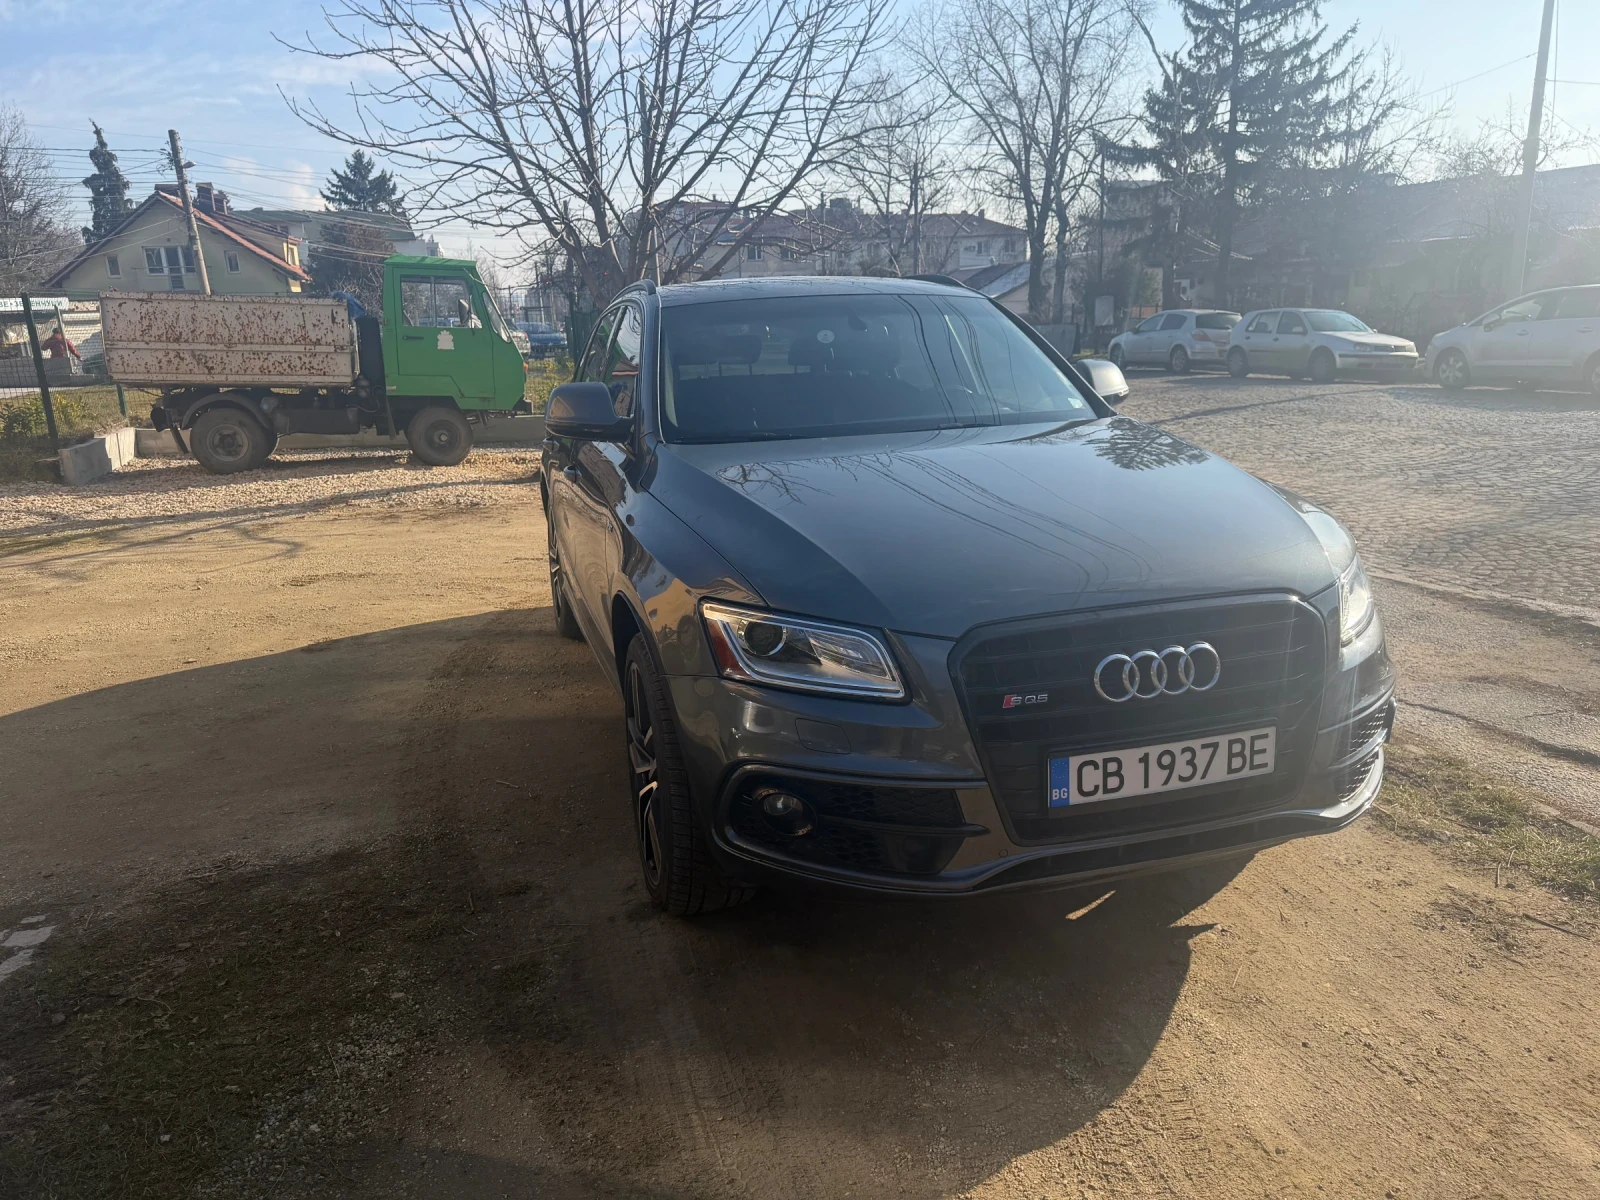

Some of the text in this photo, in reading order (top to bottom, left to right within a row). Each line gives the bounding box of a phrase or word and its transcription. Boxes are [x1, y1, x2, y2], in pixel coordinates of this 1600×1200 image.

[1076, 733, 1269, 798] CB 1937 BE
[1052, 787, 1068, 800] BG
